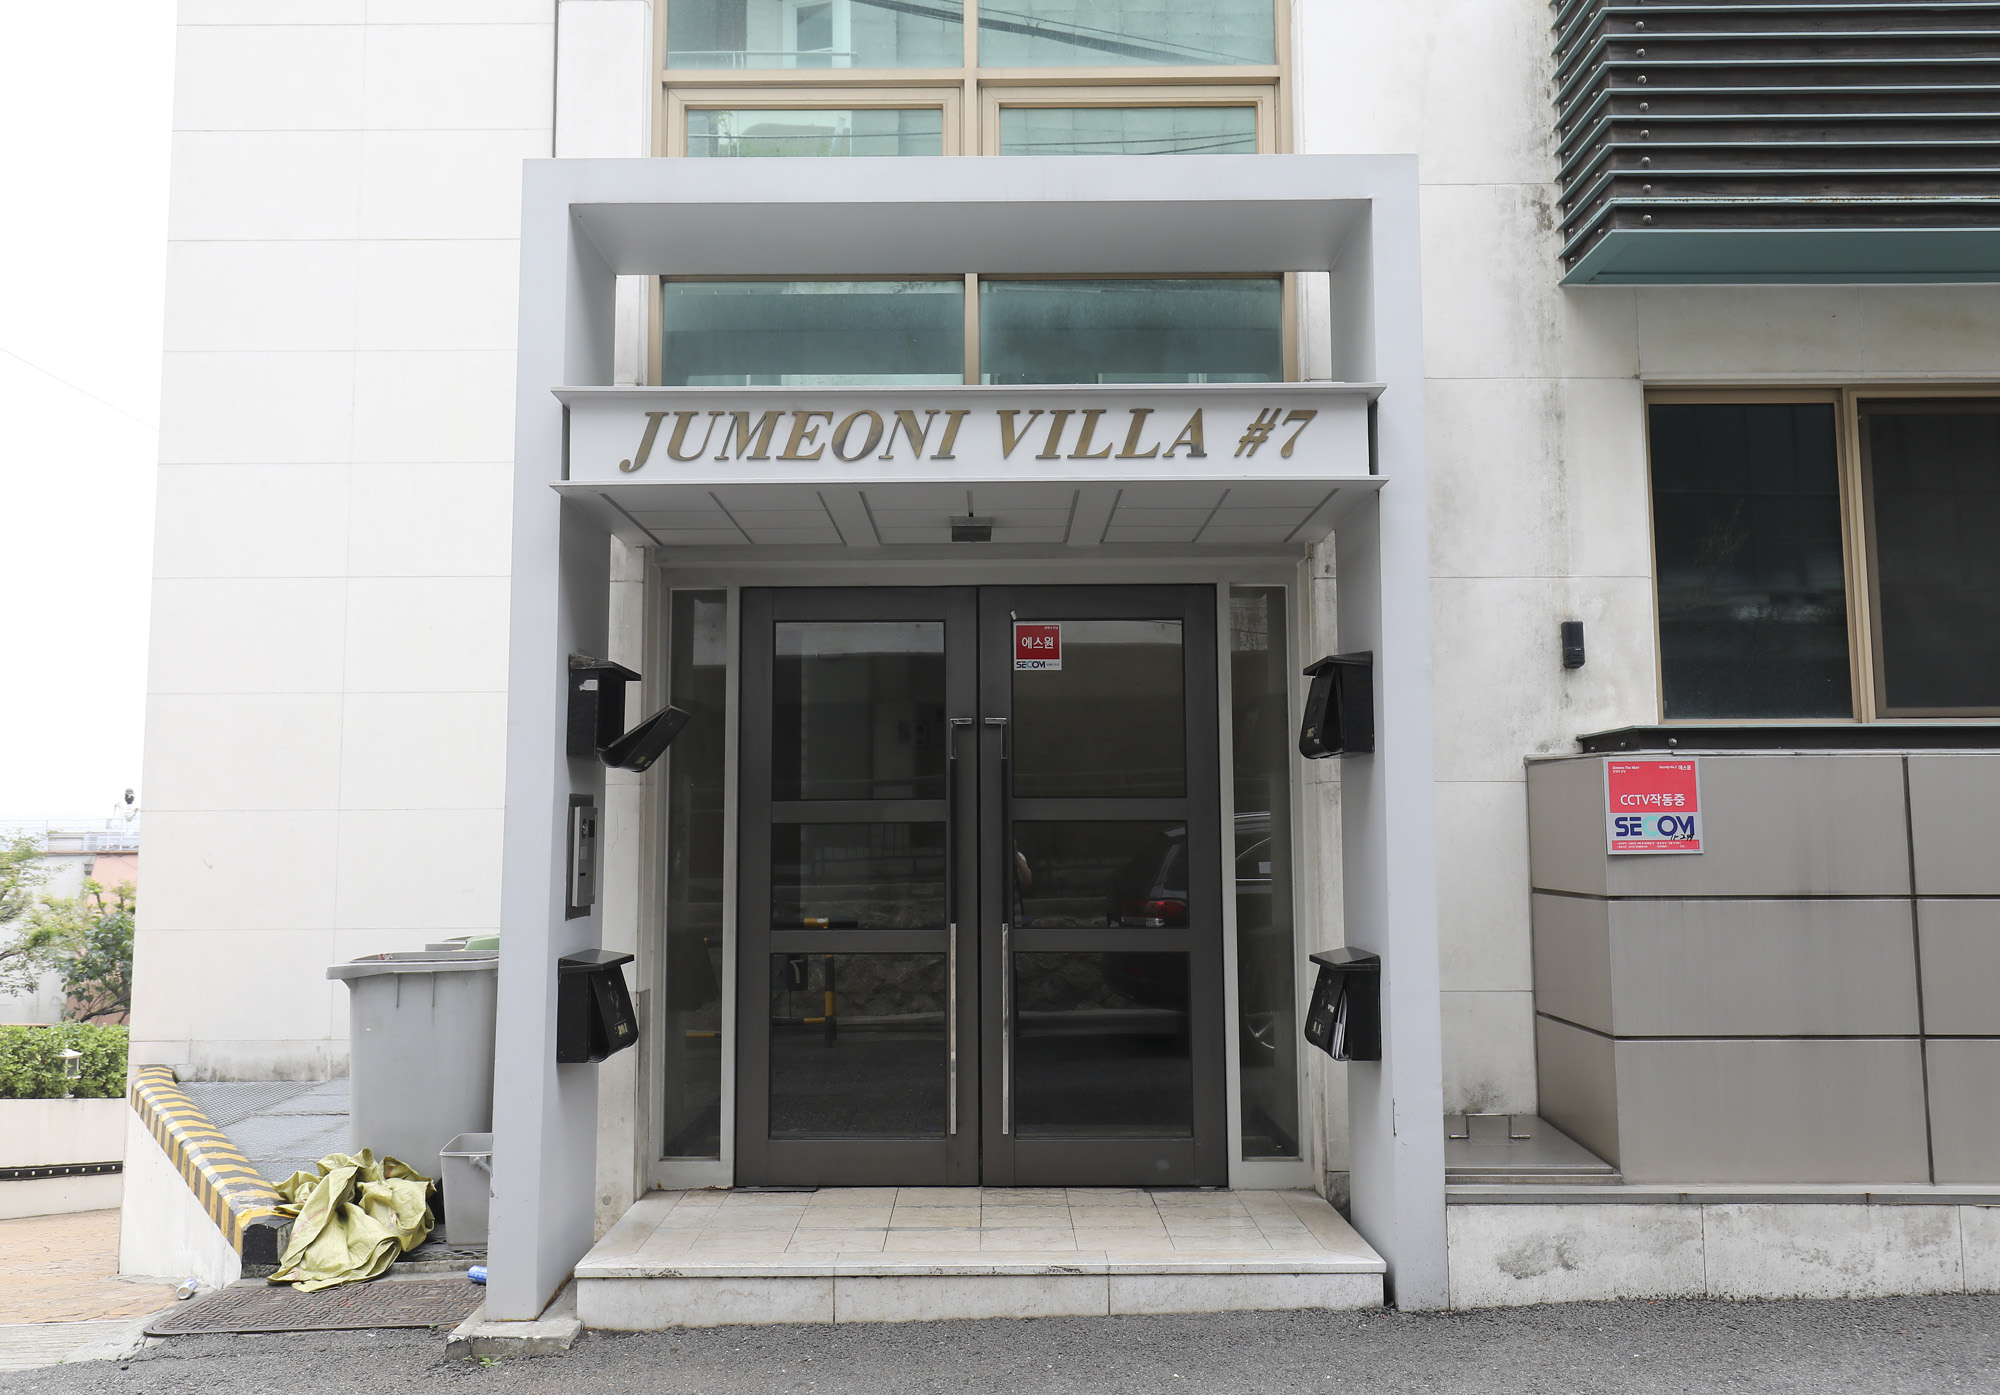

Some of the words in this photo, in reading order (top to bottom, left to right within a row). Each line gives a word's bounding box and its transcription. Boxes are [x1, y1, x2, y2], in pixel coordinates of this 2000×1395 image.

[618, 408, 972, 474] JUMEONI
[996, 406, 1208, 460] VILLA
[1234, 406, 1318, 459] #7
[1021, 636, 1054, 650] 에스원
[1016, 660, 1046, 669] SECOM
[1620, 793, 1686, 807] CCTV작동중
[1614, 815, 1695, 837] SECOM
